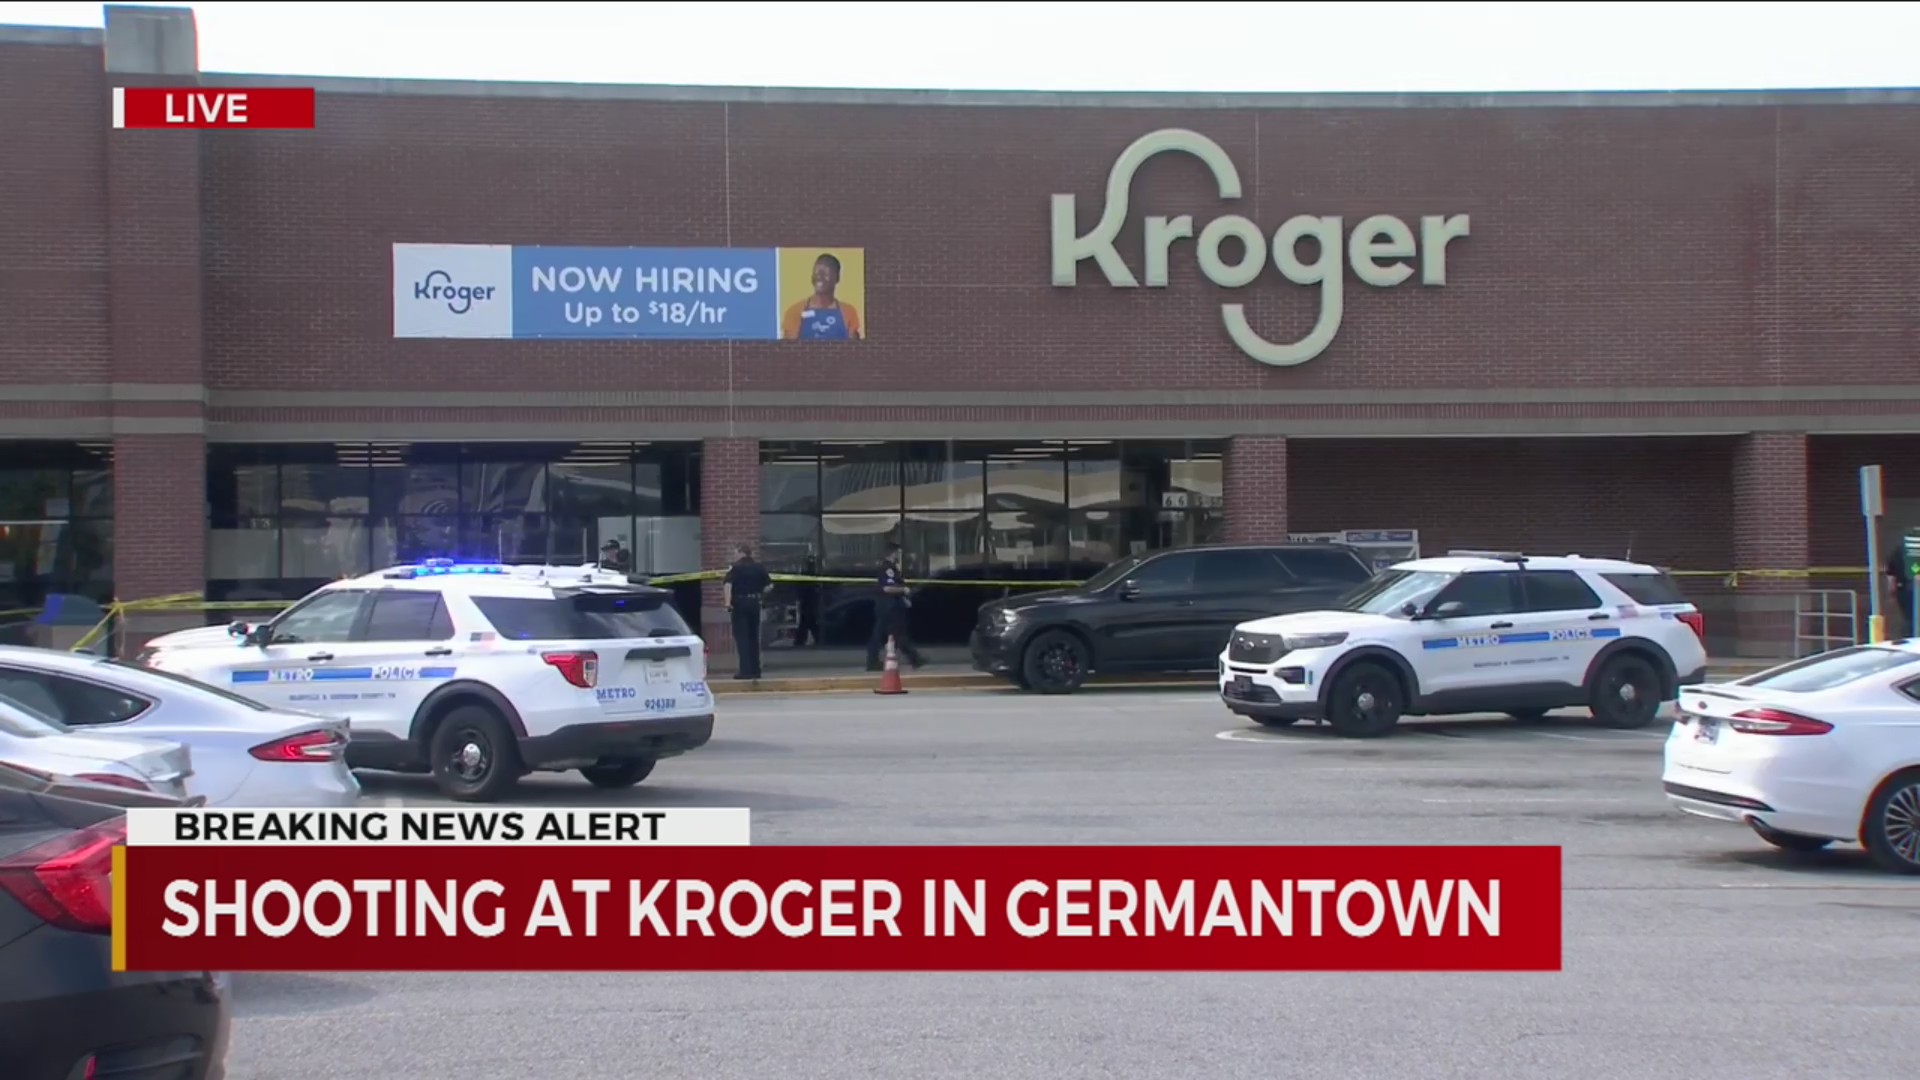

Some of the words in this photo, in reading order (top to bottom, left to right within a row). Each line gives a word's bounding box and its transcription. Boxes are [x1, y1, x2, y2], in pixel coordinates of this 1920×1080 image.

[1051, 128, 1470, 366] Kroger
[414, 269, 496, 315] Kroger
[531, 266, 621, 293] NOW
[635, 267, 759, 293] HIRING
[564, 302, 602, 327] Up
[611, 303, 641, 323] to
[649, 300, 727, 326] $18/hr
[1456, 634, 1501, 649] METRO
[1550, 628, 1592, 642] POLICE
[268, 668, 314, 681] METRO
[596, 687, 637, 700] METRO
